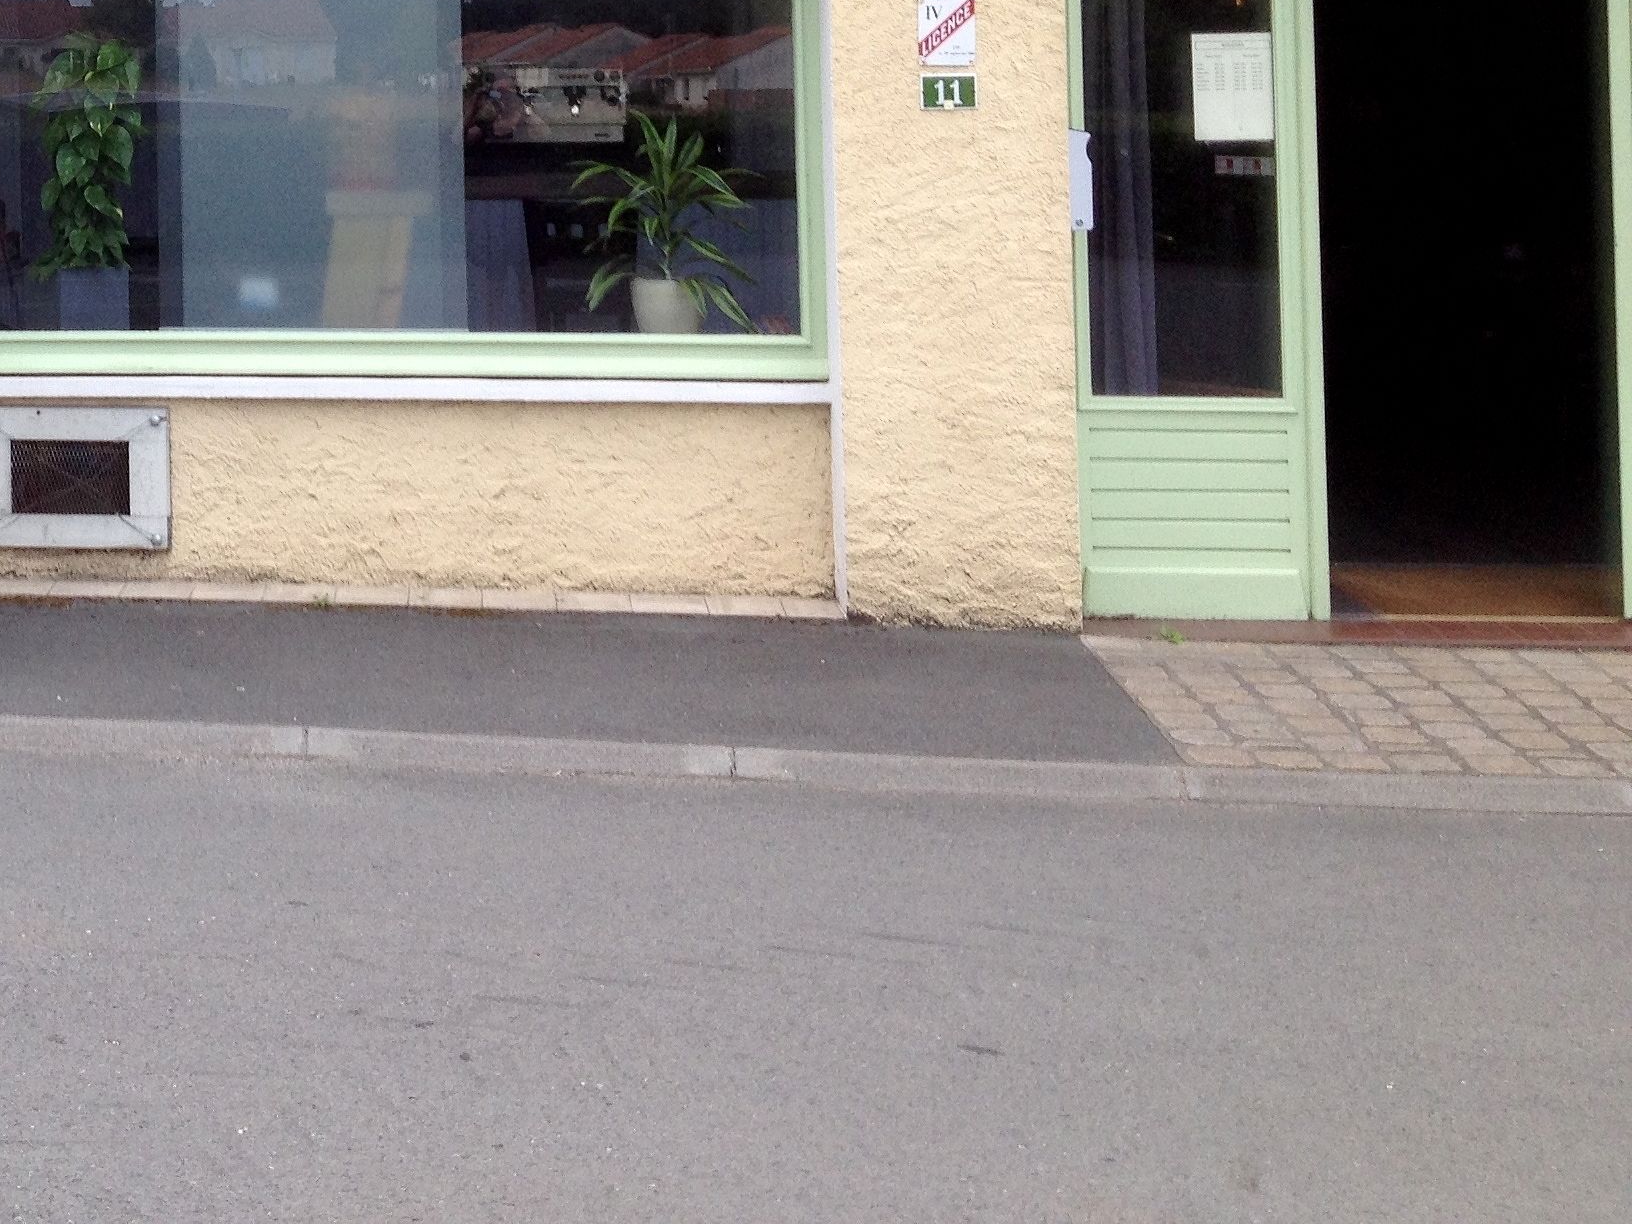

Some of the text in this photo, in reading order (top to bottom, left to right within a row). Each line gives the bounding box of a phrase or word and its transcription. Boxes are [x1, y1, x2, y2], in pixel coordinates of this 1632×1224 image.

[925, 5, 942, 20] IV
[920, 0, 974, 56] LICENCE
[934, 79, 963, 106] 11
